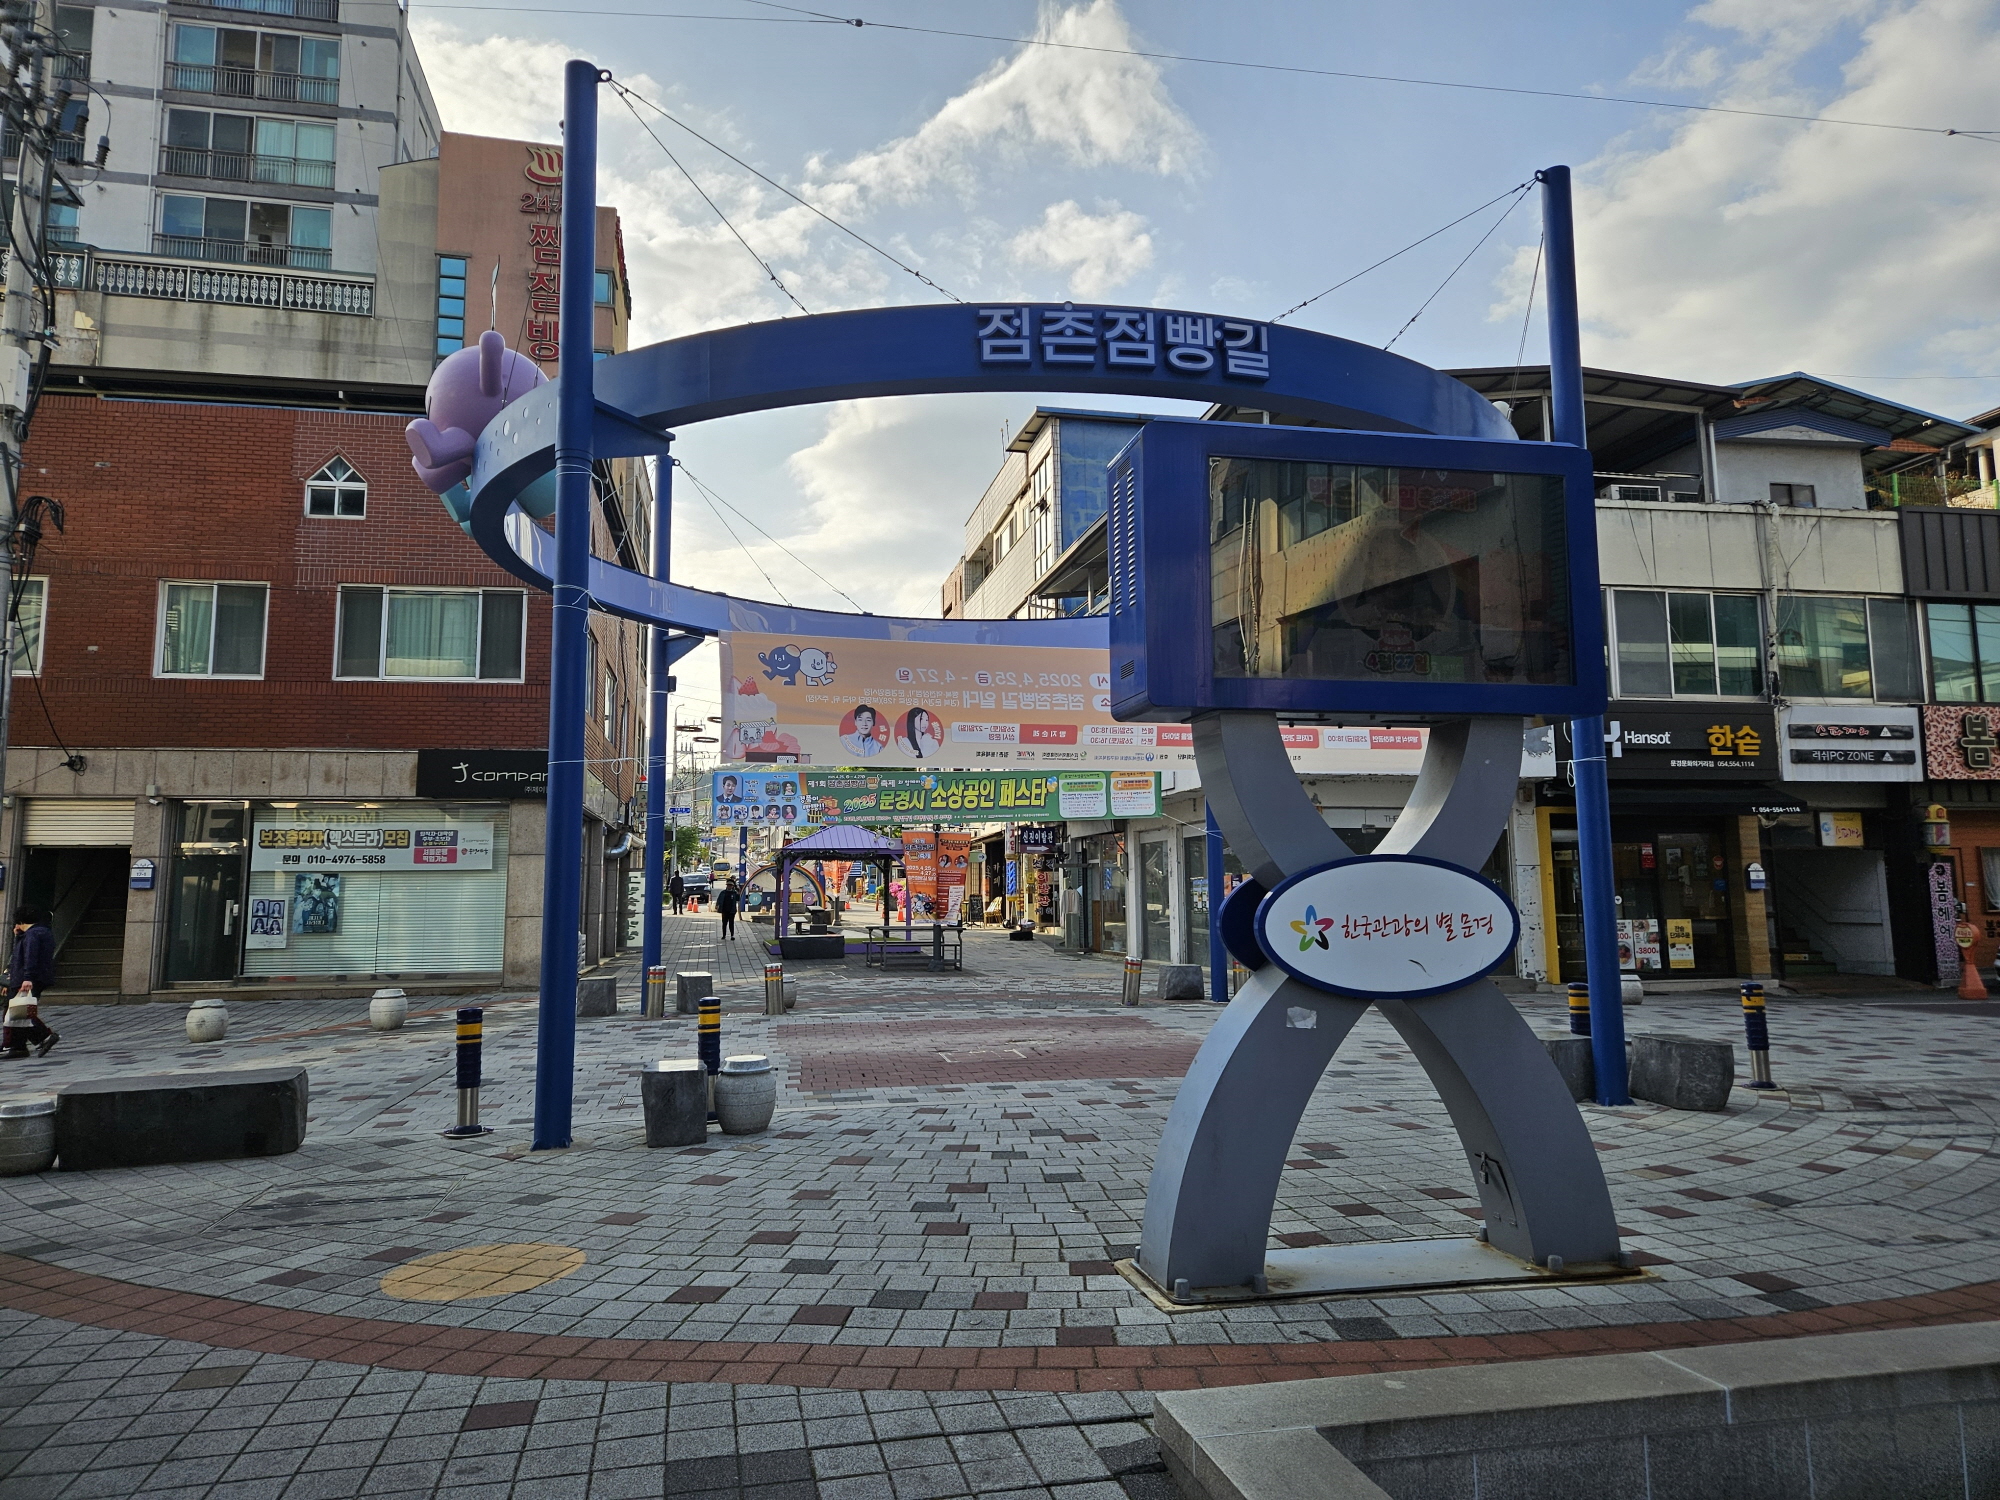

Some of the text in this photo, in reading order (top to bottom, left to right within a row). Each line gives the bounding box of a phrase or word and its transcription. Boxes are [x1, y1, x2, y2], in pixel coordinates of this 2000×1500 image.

[977, 300, 1270, 378] 점촌점빵길
[1624, 731, 1671, 745] Hansot
[1707, 725, 1761, 756] 한솥
[1960, 714, 1998, 769] 봄
[1847, 751, 1875, 761] ZONE
[843, 793, 877, 814] 2025
[879, 789, 927, 812] 문경시
[930, 778, 996, 810] 소상공인
[999, 777, 1049, 808] 페스타
[1022, 830, 1054, 844] 신진이발관
[282, 854, 386, 865] 문의 010-4976-5858
[1341, 911, 1494, 942] 한국관광의 별 문경
